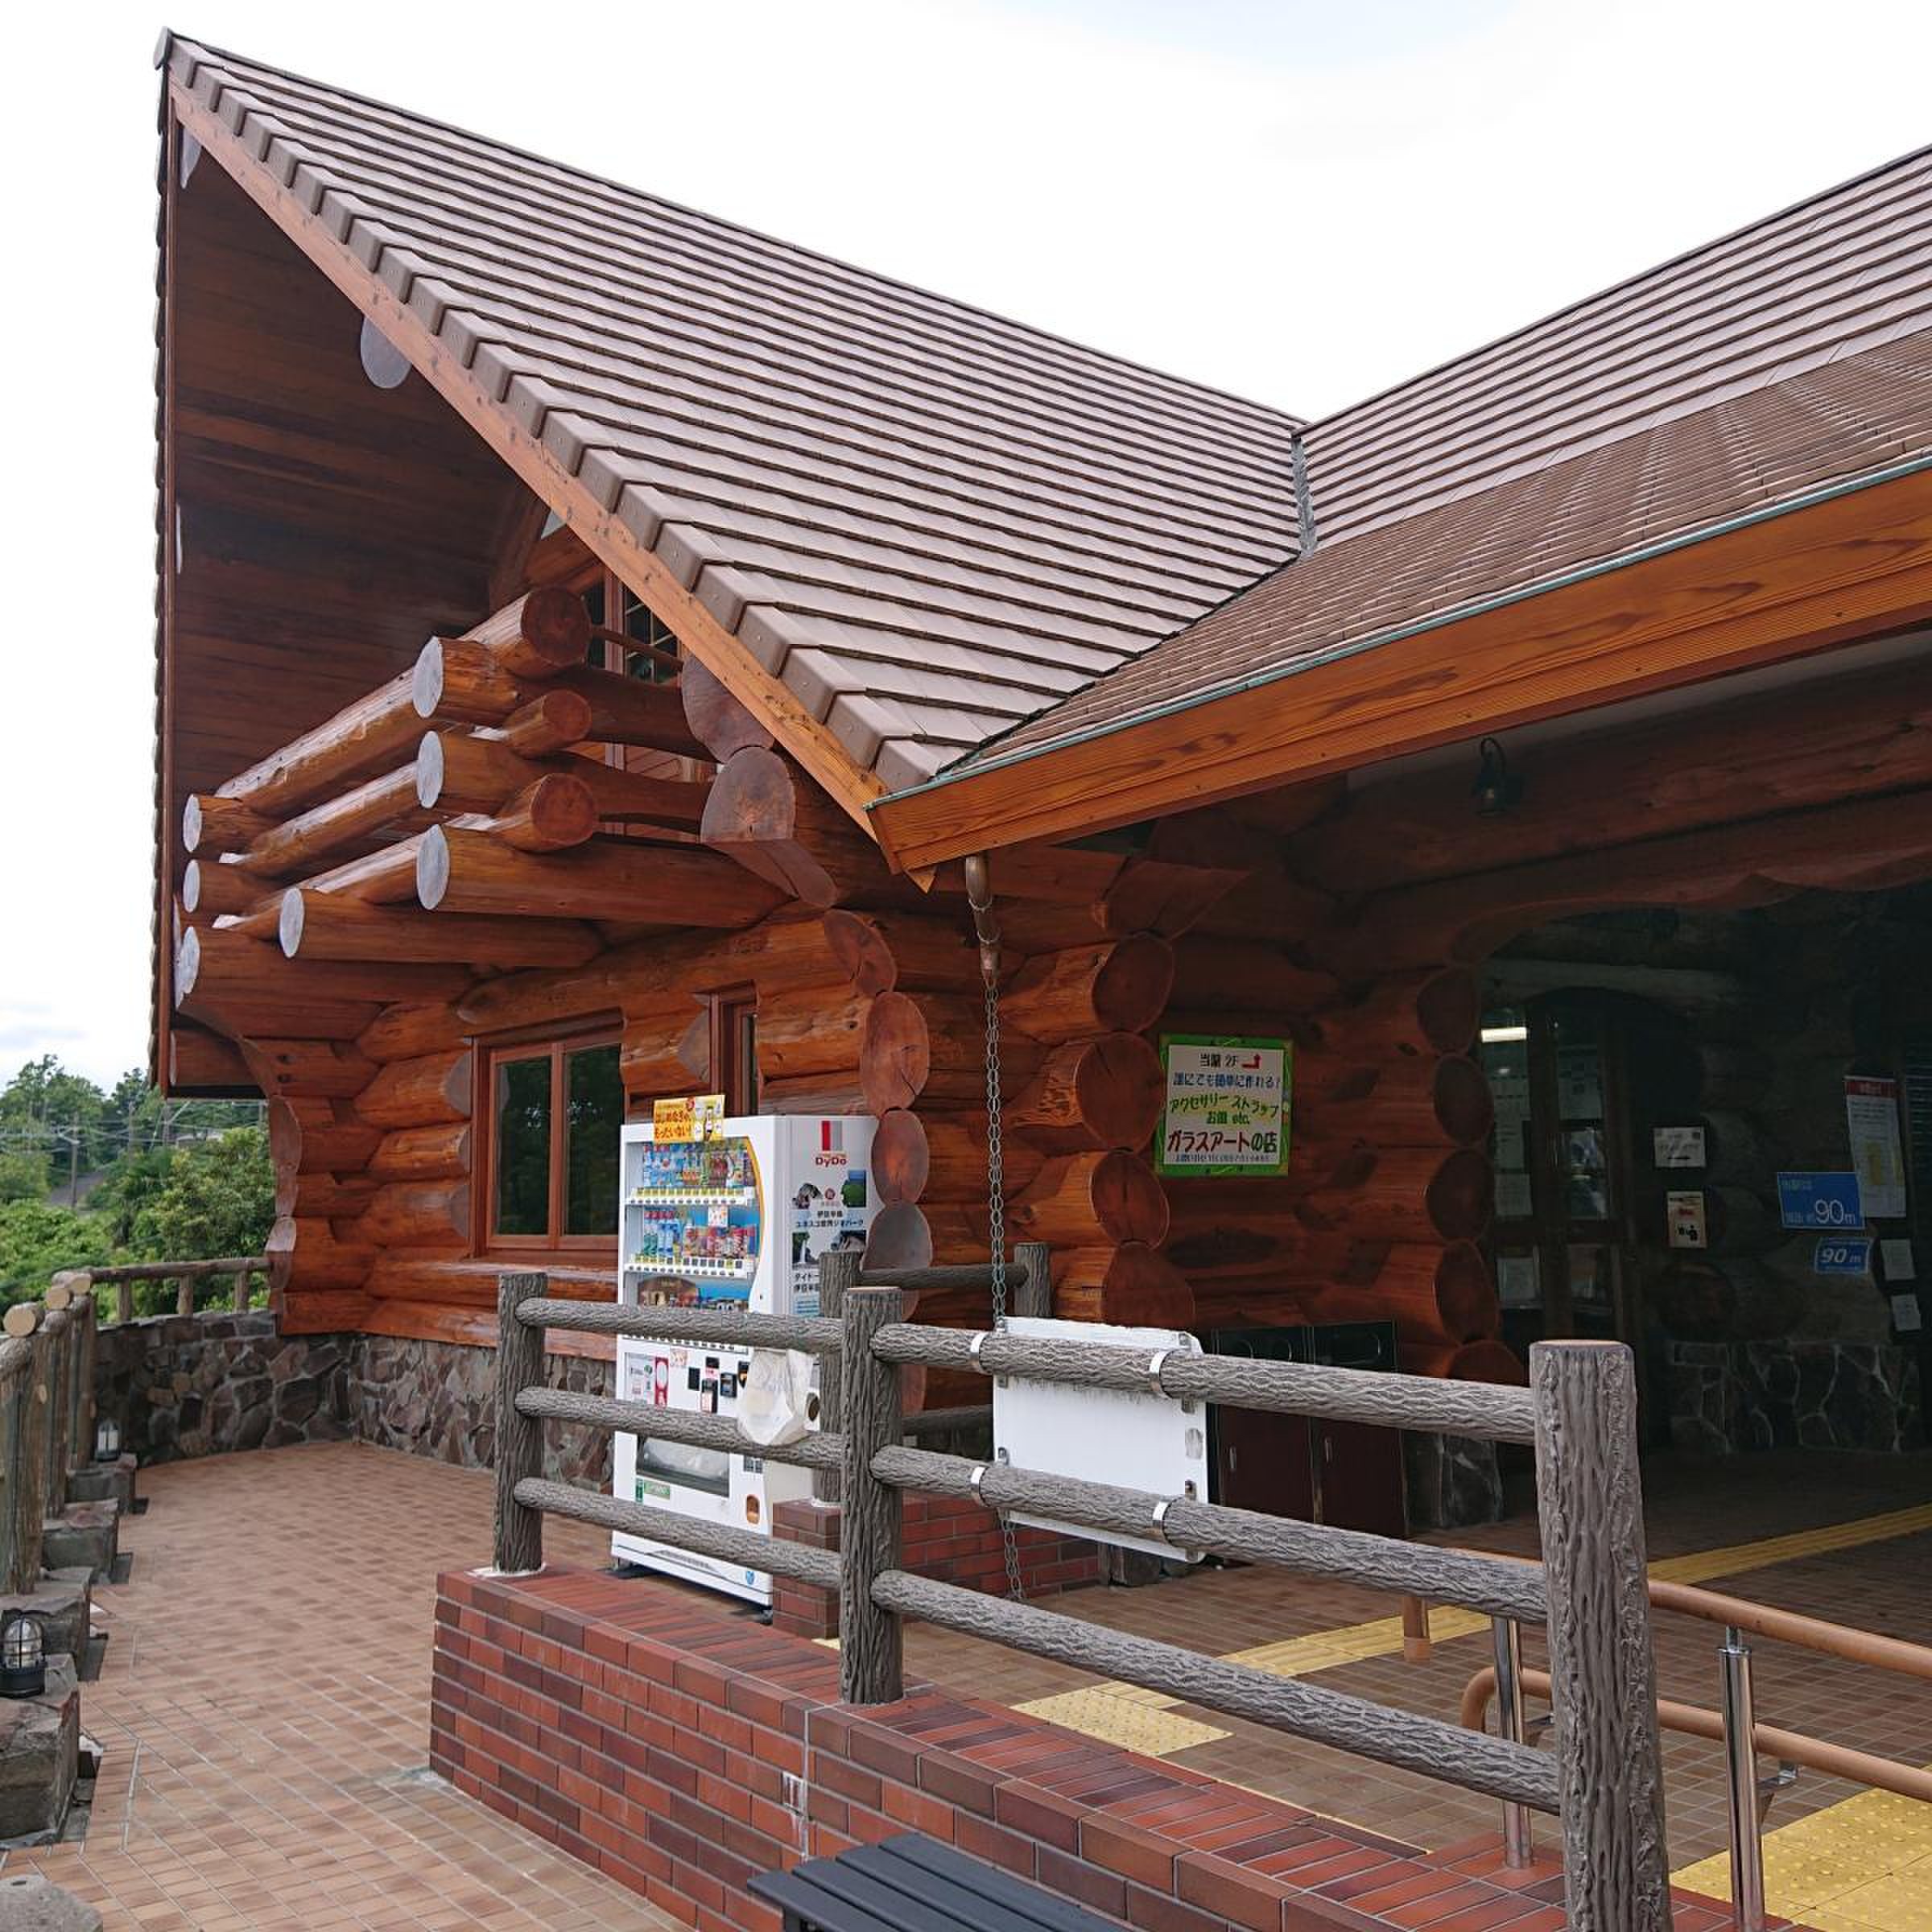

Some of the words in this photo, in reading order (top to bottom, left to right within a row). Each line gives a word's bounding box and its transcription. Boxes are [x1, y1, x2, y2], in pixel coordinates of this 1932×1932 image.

[1170, 1092, 1229, 1113] アクセサリー
[1231, 1094, 1279, 1118] ストラップ
[1167, 1129, 1278, 1154] ガラスアートの店
[815, 1157, 847, 1167] DyDo
